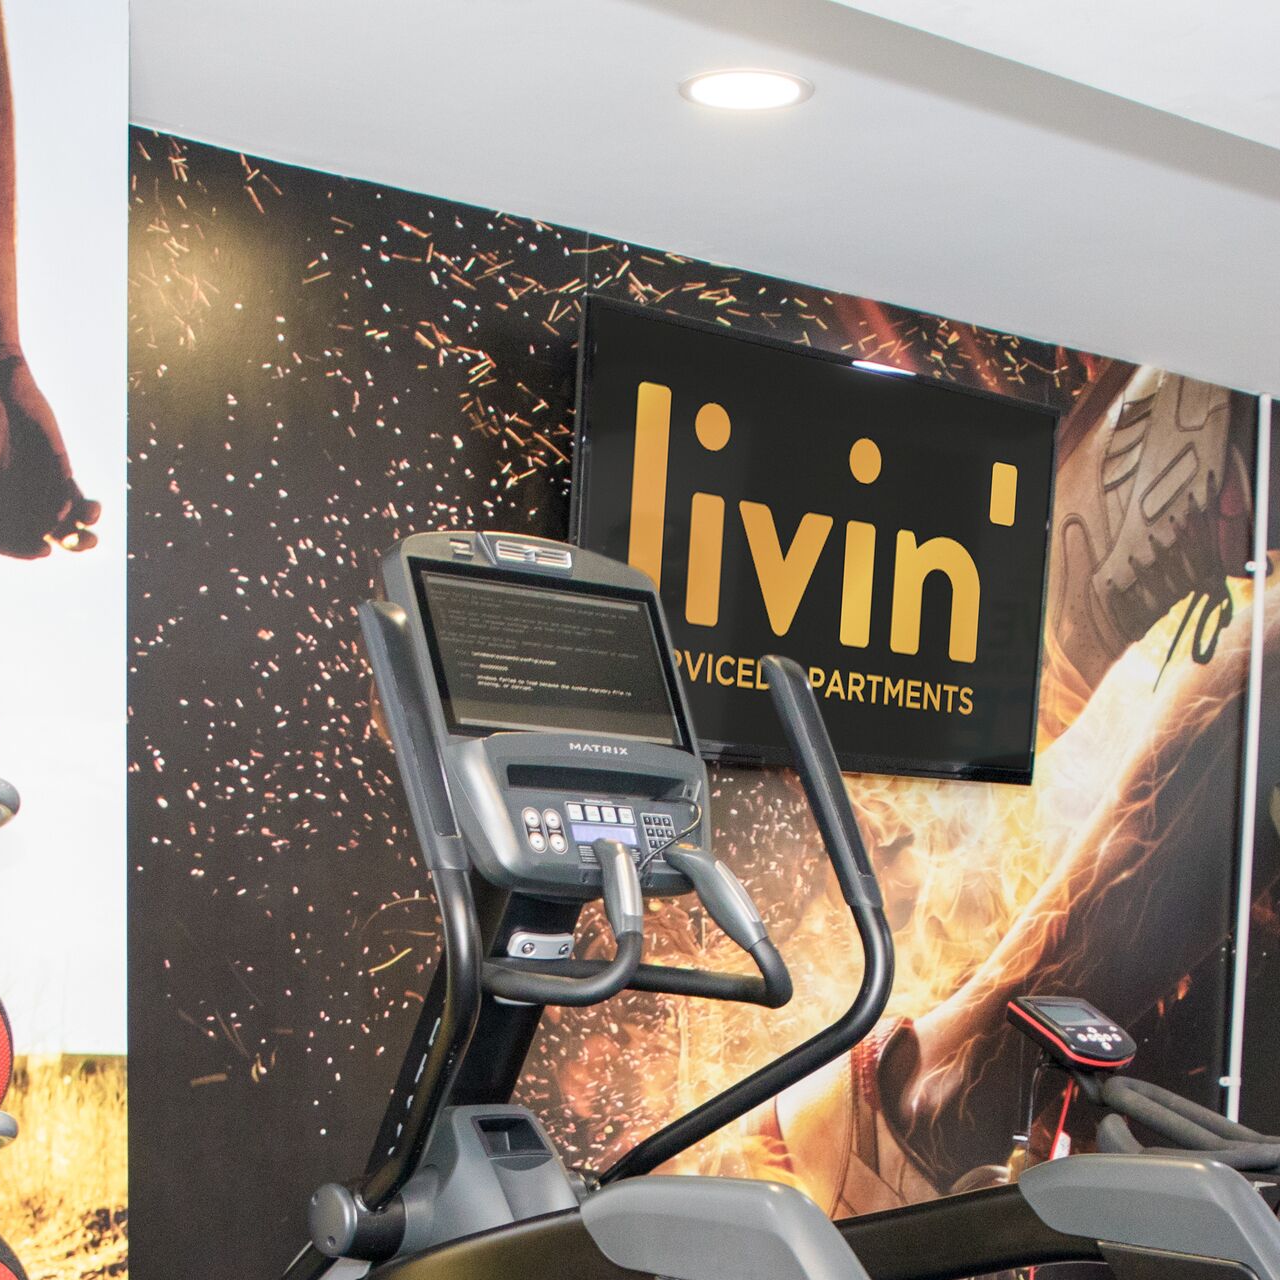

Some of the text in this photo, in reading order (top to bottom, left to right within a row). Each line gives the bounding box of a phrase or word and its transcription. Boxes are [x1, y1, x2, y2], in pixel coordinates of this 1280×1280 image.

[628, 381, 1018, 663] livin'
[808, 666, 974, 716] PARTMENTS
[568, 741, 629, 757] MATRIX
